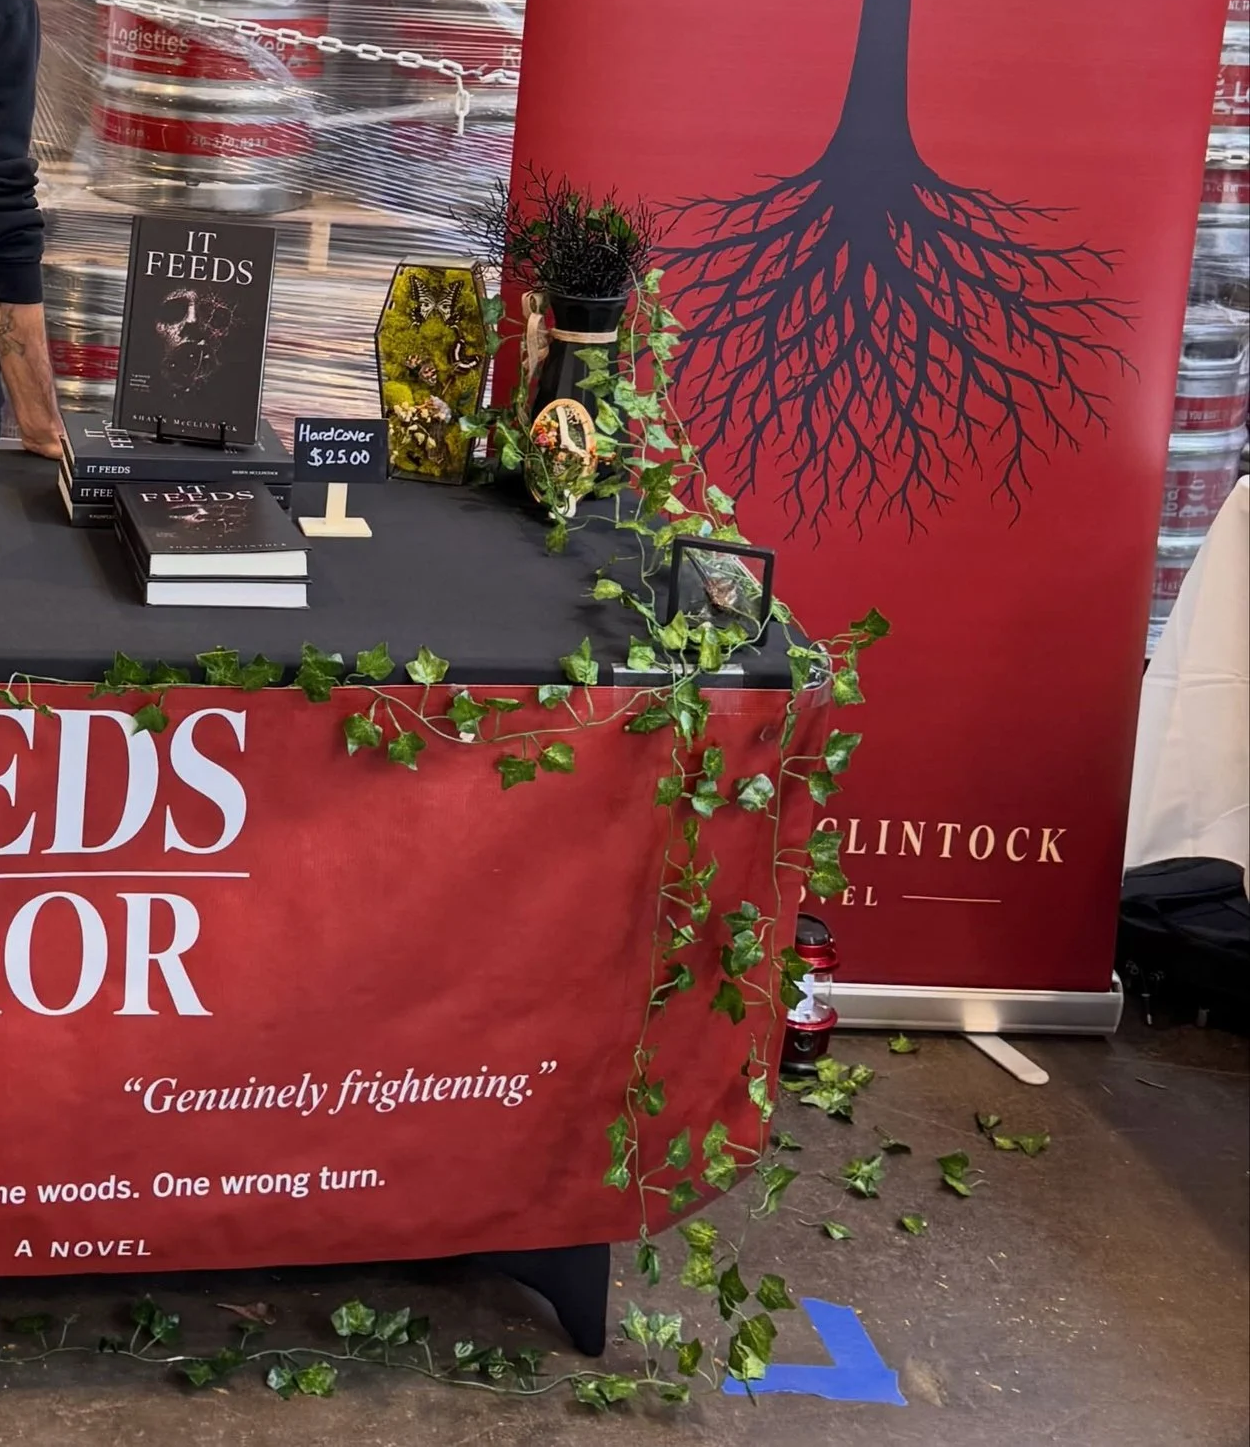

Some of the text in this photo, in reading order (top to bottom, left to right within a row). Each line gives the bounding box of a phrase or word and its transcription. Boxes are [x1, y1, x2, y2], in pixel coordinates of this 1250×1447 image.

[185, 230, 217, 254] IT
[145, 250, 254, 286] FEEDS
[173, 419, 238, 432] McCLINTCK
[86, 464, 97, 474] IT
[98, 465, 131, 475] FEEDS
[80, 488, 114, 498] IT FEE
[139, 490, 255, 503] FEEDS
[176, 485, 206, 495] IT
[122, 1059, 559, 1118] “Genuinely frightening.”
[36, 1175, 141, 1205] woods.
[151, 1170, 212, 1201] One
[218, 1168, 312, 1202] wrong
[317, 1163, 387, 1194] turn.
[13, 1237, 34, 1259] A
[50, 1237, 153, 1259] NOVEL
